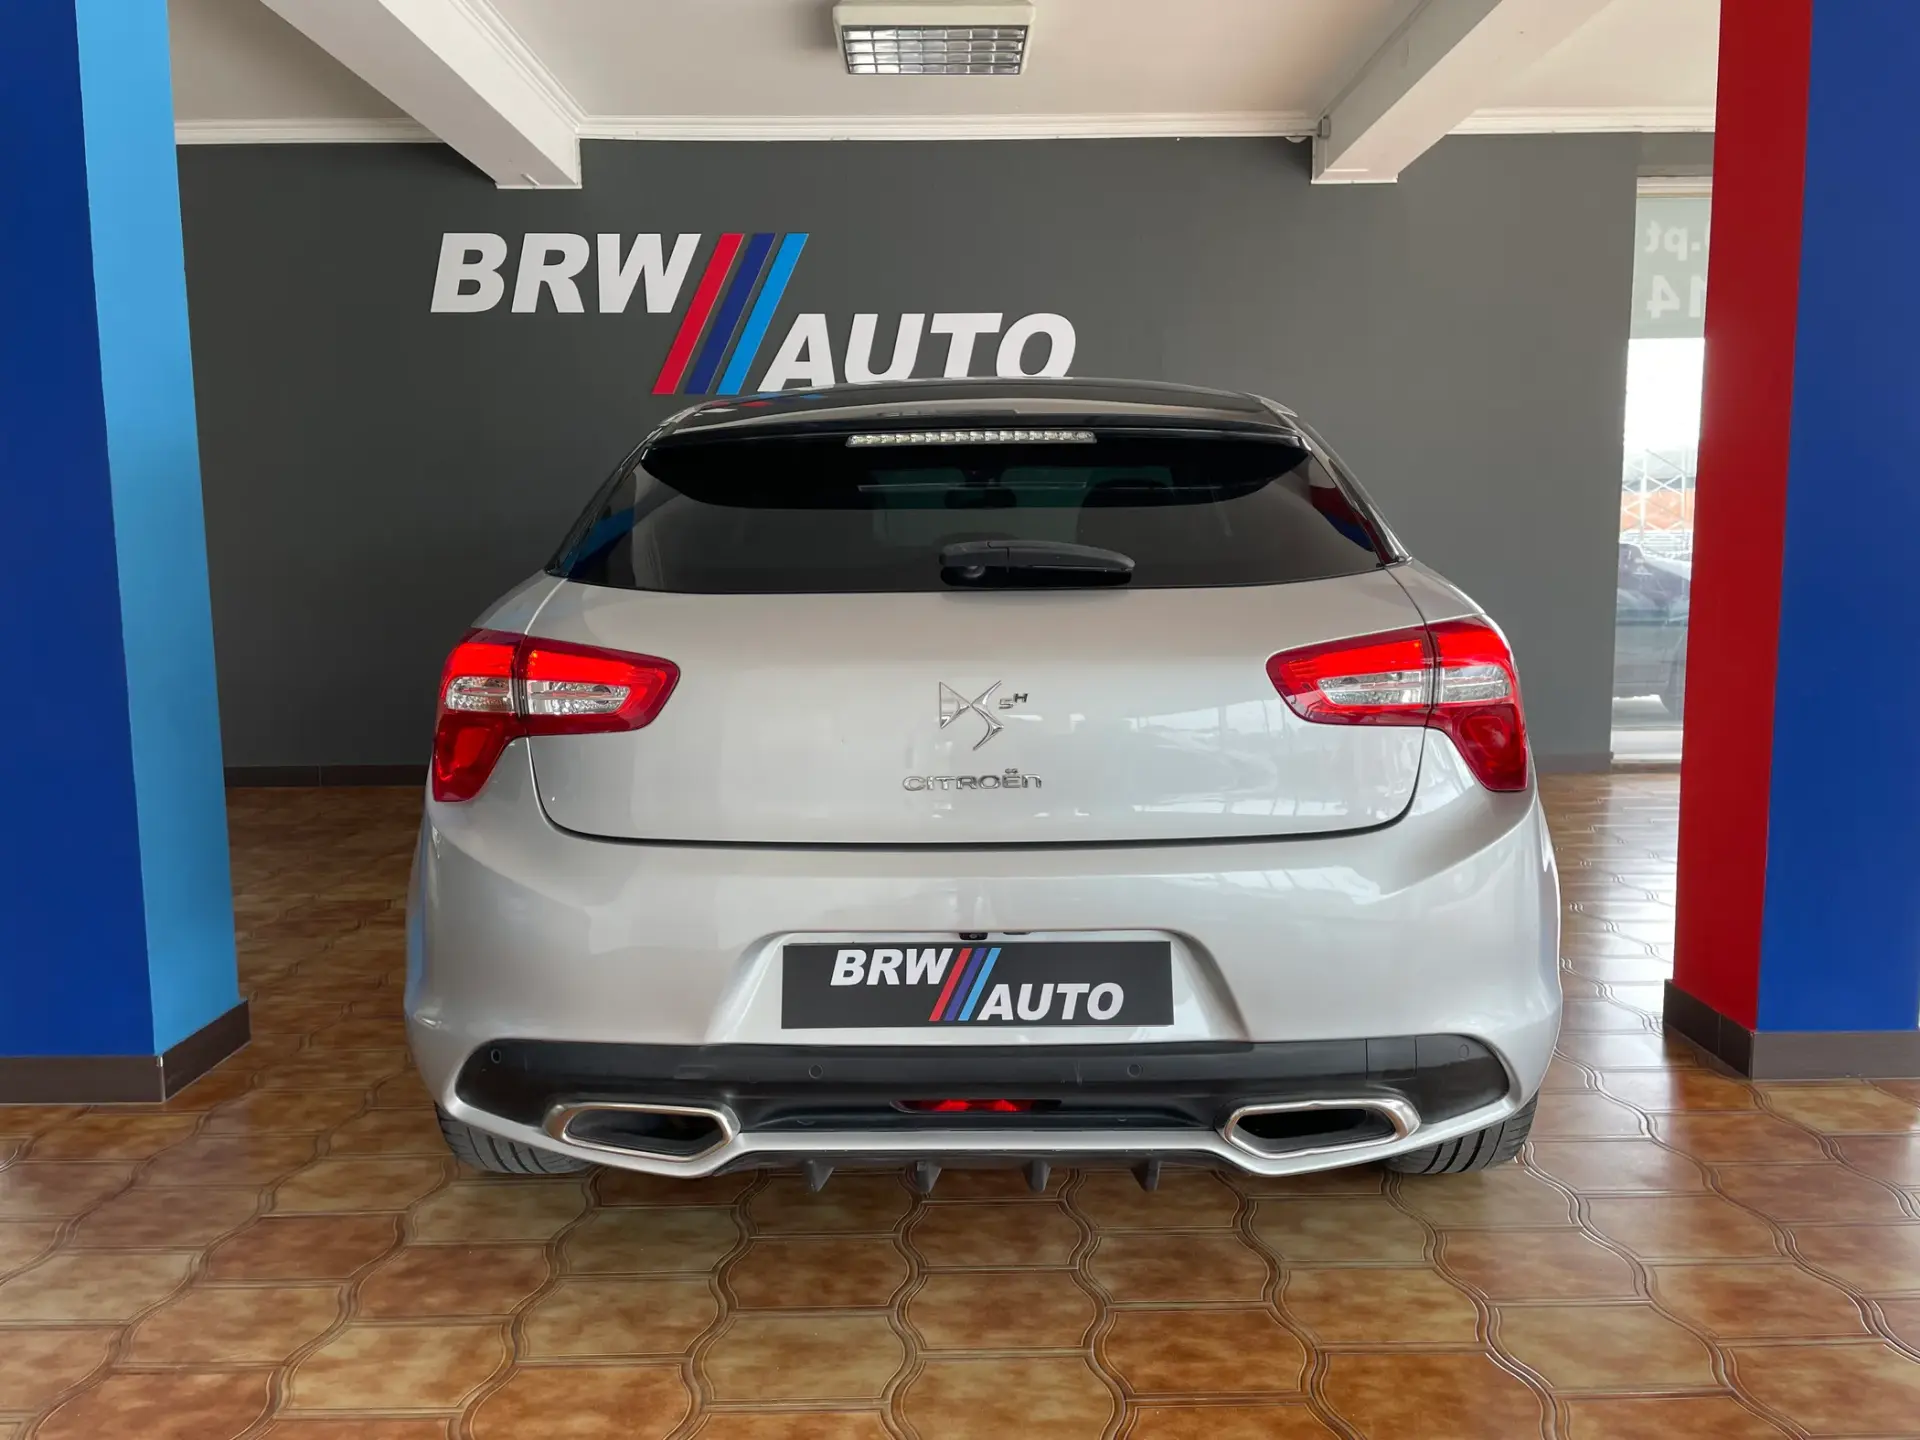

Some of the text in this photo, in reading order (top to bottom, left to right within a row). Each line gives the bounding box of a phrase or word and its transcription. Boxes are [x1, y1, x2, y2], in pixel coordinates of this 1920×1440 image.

[430, 232, 702, 314] BRW
[756, 313, 1078, 393] AUTO
[830, 948, 953, 987] BRW
[976, 982, 1125, 1021] AUTO
